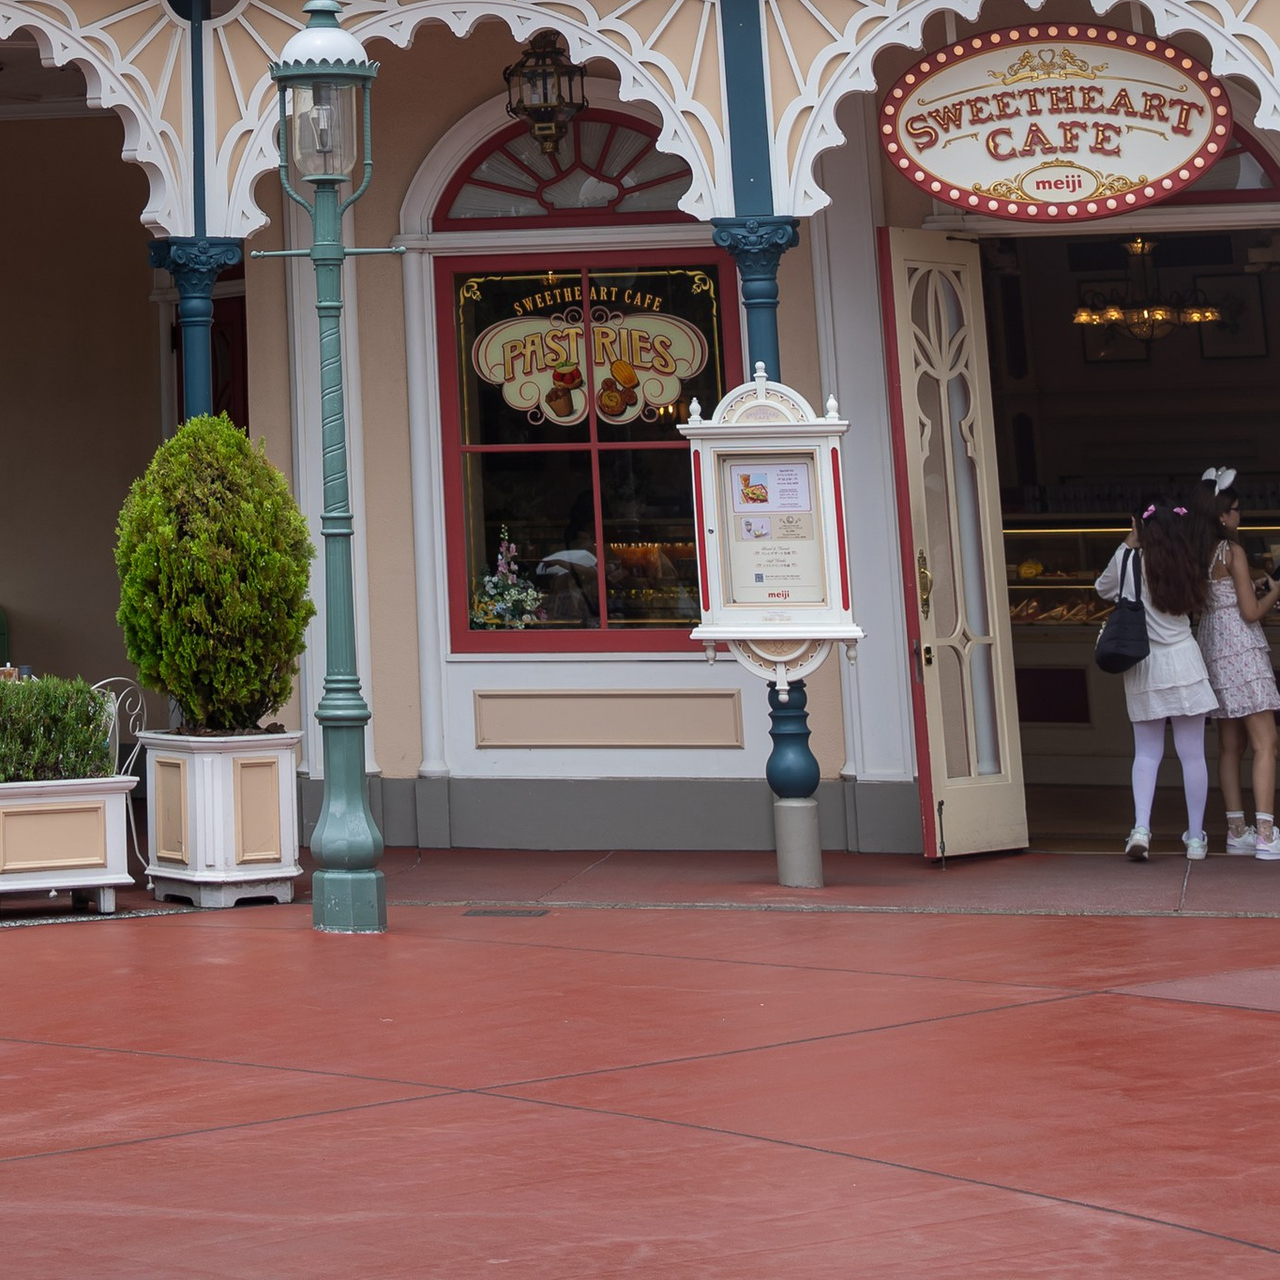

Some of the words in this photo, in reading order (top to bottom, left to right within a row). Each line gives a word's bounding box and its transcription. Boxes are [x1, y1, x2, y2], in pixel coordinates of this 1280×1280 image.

[905, 85, 1205, 153] SWEETHEART
[985, 121, 1123, 162] CAFE
[1035, 174, 1083, 193] meiji
[513, 286, 618, 316] SWEETHEART
[624, 289, 663, 312] CAFE
[502, 326, 678, 383] PASTRIES
[768, 590, 790, 600] meiji
